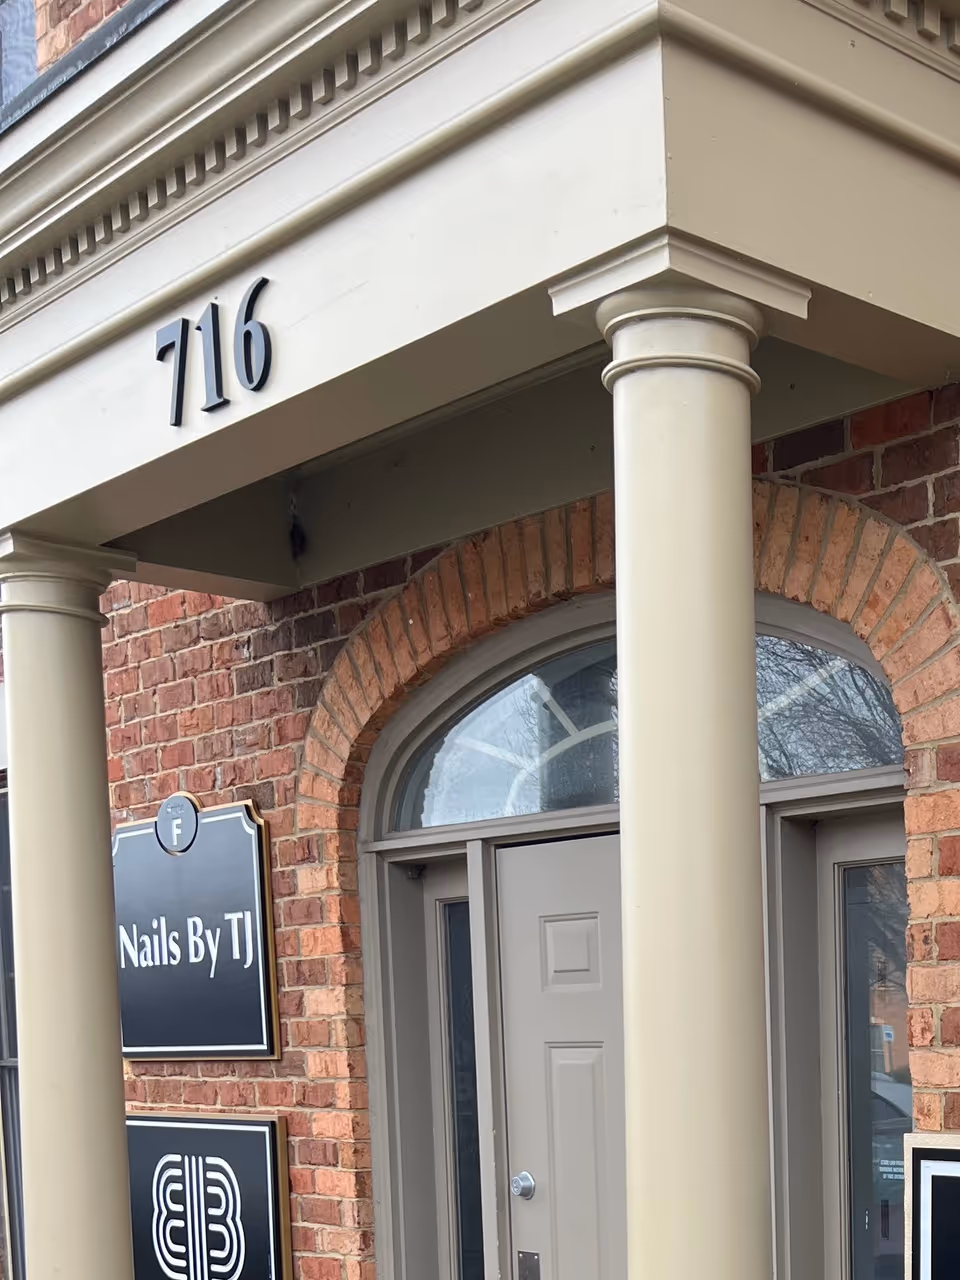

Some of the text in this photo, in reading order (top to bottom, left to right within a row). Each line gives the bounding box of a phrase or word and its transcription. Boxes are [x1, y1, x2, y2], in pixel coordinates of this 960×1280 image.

[156, 277, 272, 427] 716
[172, 818, 182, 846] F
[119, 911, 253, 978] Nails By TJ
